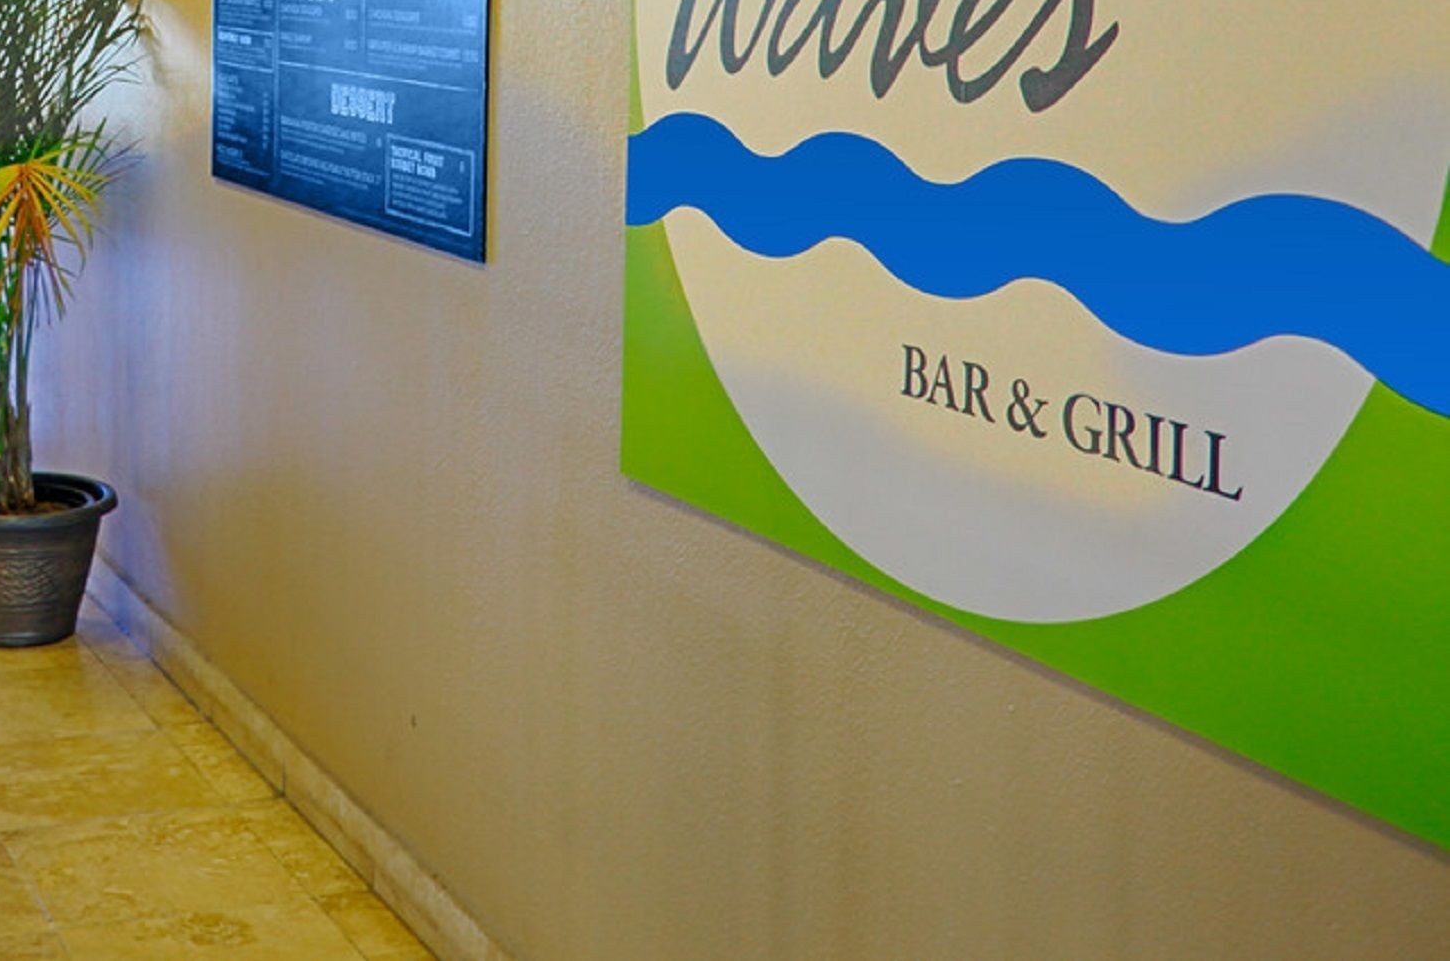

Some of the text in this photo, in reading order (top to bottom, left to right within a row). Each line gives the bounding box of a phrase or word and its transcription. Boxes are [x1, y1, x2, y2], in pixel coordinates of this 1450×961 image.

[331, 83, 395, 125] DESSERT
[901, 344, 1243, 501] BAR & GRILL
